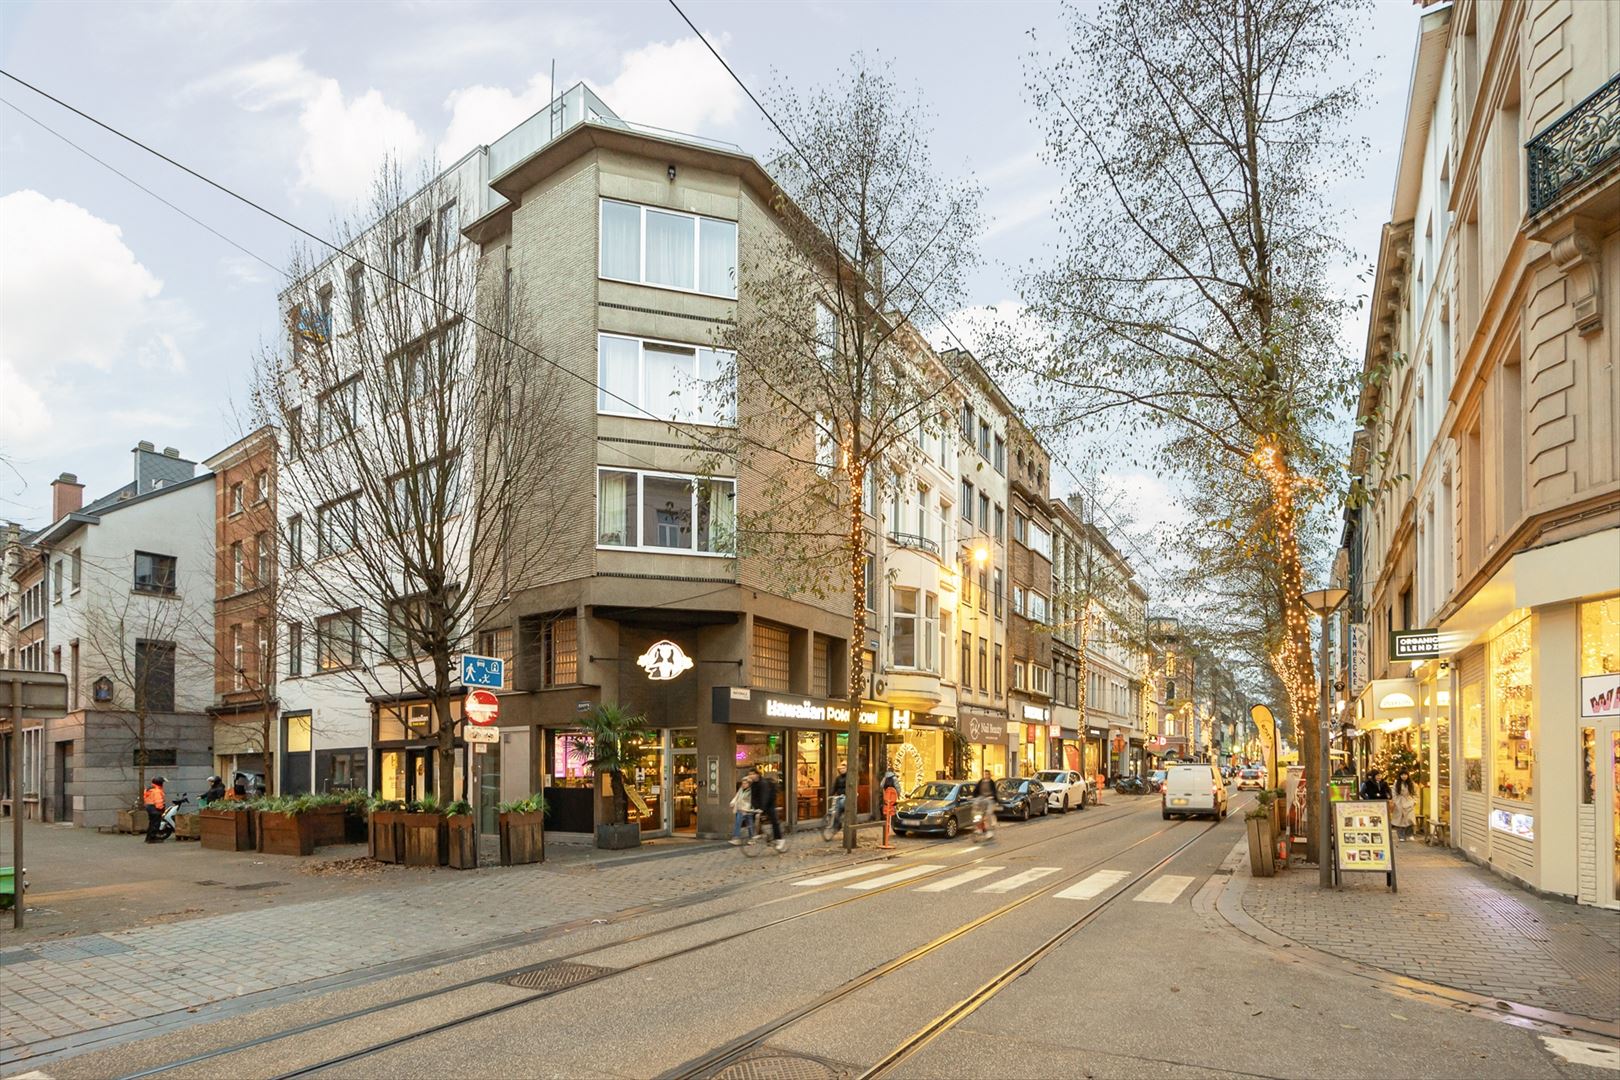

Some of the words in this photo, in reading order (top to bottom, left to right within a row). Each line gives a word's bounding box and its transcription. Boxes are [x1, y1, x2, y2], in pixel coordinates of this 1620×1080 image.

[1399, 636, 1439, 646] ORGANIC
[1399, 644, 1439, 653] BLENDZ
[766, 699, 826, 721] Hawaiian
[827, 706, 851, 723] Pok
[857, 710, 878, 725] owl
